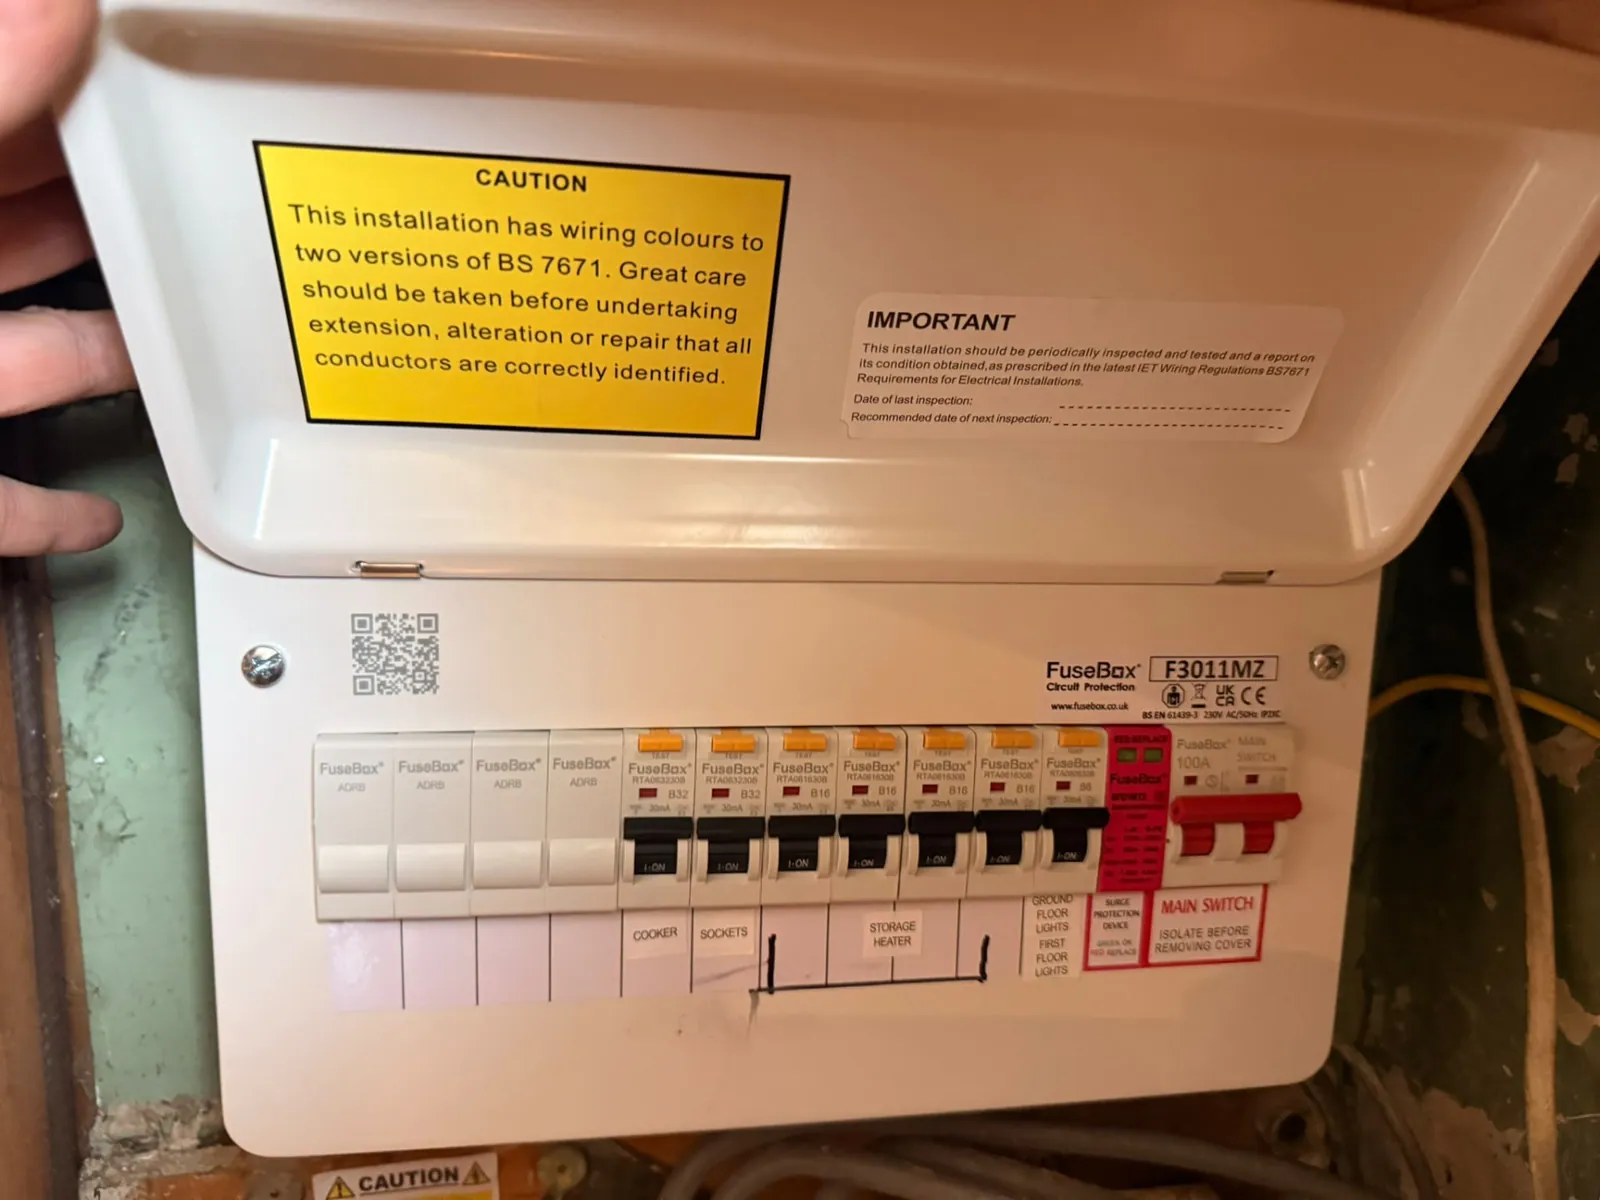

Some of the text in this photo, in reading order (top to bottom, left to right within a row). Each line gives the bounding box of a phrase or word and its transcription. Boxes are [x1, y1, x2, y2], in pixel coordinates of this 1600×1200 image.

[475, 168, 588, 192] CAUTION
[287, 204, 764, 252] This installation has wiring colours to
[295, 243, 747, 287] two versions of BS 7671. Great care
[302, 280, 738, 325] should be taken before undertaking
[867, 310, 1017, 331] IMPORTANT
[308, 316, 752, 355] extension, alteration or repair that all
[862, 342, 1315, 364] This installation should be periodically inspected and tested and a report on
[315, 351, 725, 385] conductors are correctly identified.
[859, 358, 873, 369] its
[875, 358, 931, 370] condition
[1004, 361, 1069, 374] prescribed
[1069, 362, 1081, 372] in
[1082, 362, 1101, 373] the
[1103, 363, 1136, 373] latest
[1137, 364, 1159, 373] IET
[1160, 363, 1196, 376] Wiring
[1197, 364, 1265, 377] Regulations
[1265, 366, 1310, 377] BS7671
[856, 372, 1085, 387] Requirements for Electrical Installations.
[853, 394, 973, 407] Date of last inspection:
[851, 411, 1053, 425] Recommended date of next inspection:
[1164, 659, 1266, 680] F3011MZ
[1046, 682, 1136, 692] Circuit Protection
[1051, 701, 1130, 711] www.fusebox.co.uk
[1142, 711, 1153, 720] BS
[1154, 711, 1166, 720] EN
[1167, 710, 1199, 719] 61439-3
[1177, 756, 1212, 769] 100A
[1237, 752, 1277, 762] SWITCH
[337, 782, 366, 793] ADRB
[416, 780, 445, 790] ADRB
[494, 779, 522, 789] ADRB
[570, 777, 598, 788] ADRB
[668, 789, 689, 800] B32
[740, 789, 761, 799] B32
[811, 788, 831, 798] B16
[878, 786, 897, 796] B16
[949, 785, 968, 795] B16
[1016, 784, 1036, 794] B16
[1032, 894, 1074, 906] GROUND
[1105, 897, 1131, 907] SURGE
[1161, 896, 1255, 915] MAIN SWITCH
[1036, 908, 1069, 920] FLOOR
[1093, 909, 1140, 919] PROTECTION
[869, 921, 917, 934] STORAGE
[1036, 922, 1070, 934] LIGHTS
[1102, 921, 1129, 931] DEVICE
[633, 926, 679, 941] COOKER
[700, 926, 749, 940] SOCKETS
[1159, 925, 1250, 940] ISOLATE BEFORE
[873, 935, 912, 948] HEATER
[1039, 938, 1066, 949] FIRST
[1154, 938, 1252, 954] REMOVING COVER
[1036, 952, 1069, 964] FLOOR
[1035, 965, 1069, 977] LIGHTS
[358, 1165, 460, 1192] CAUTION
